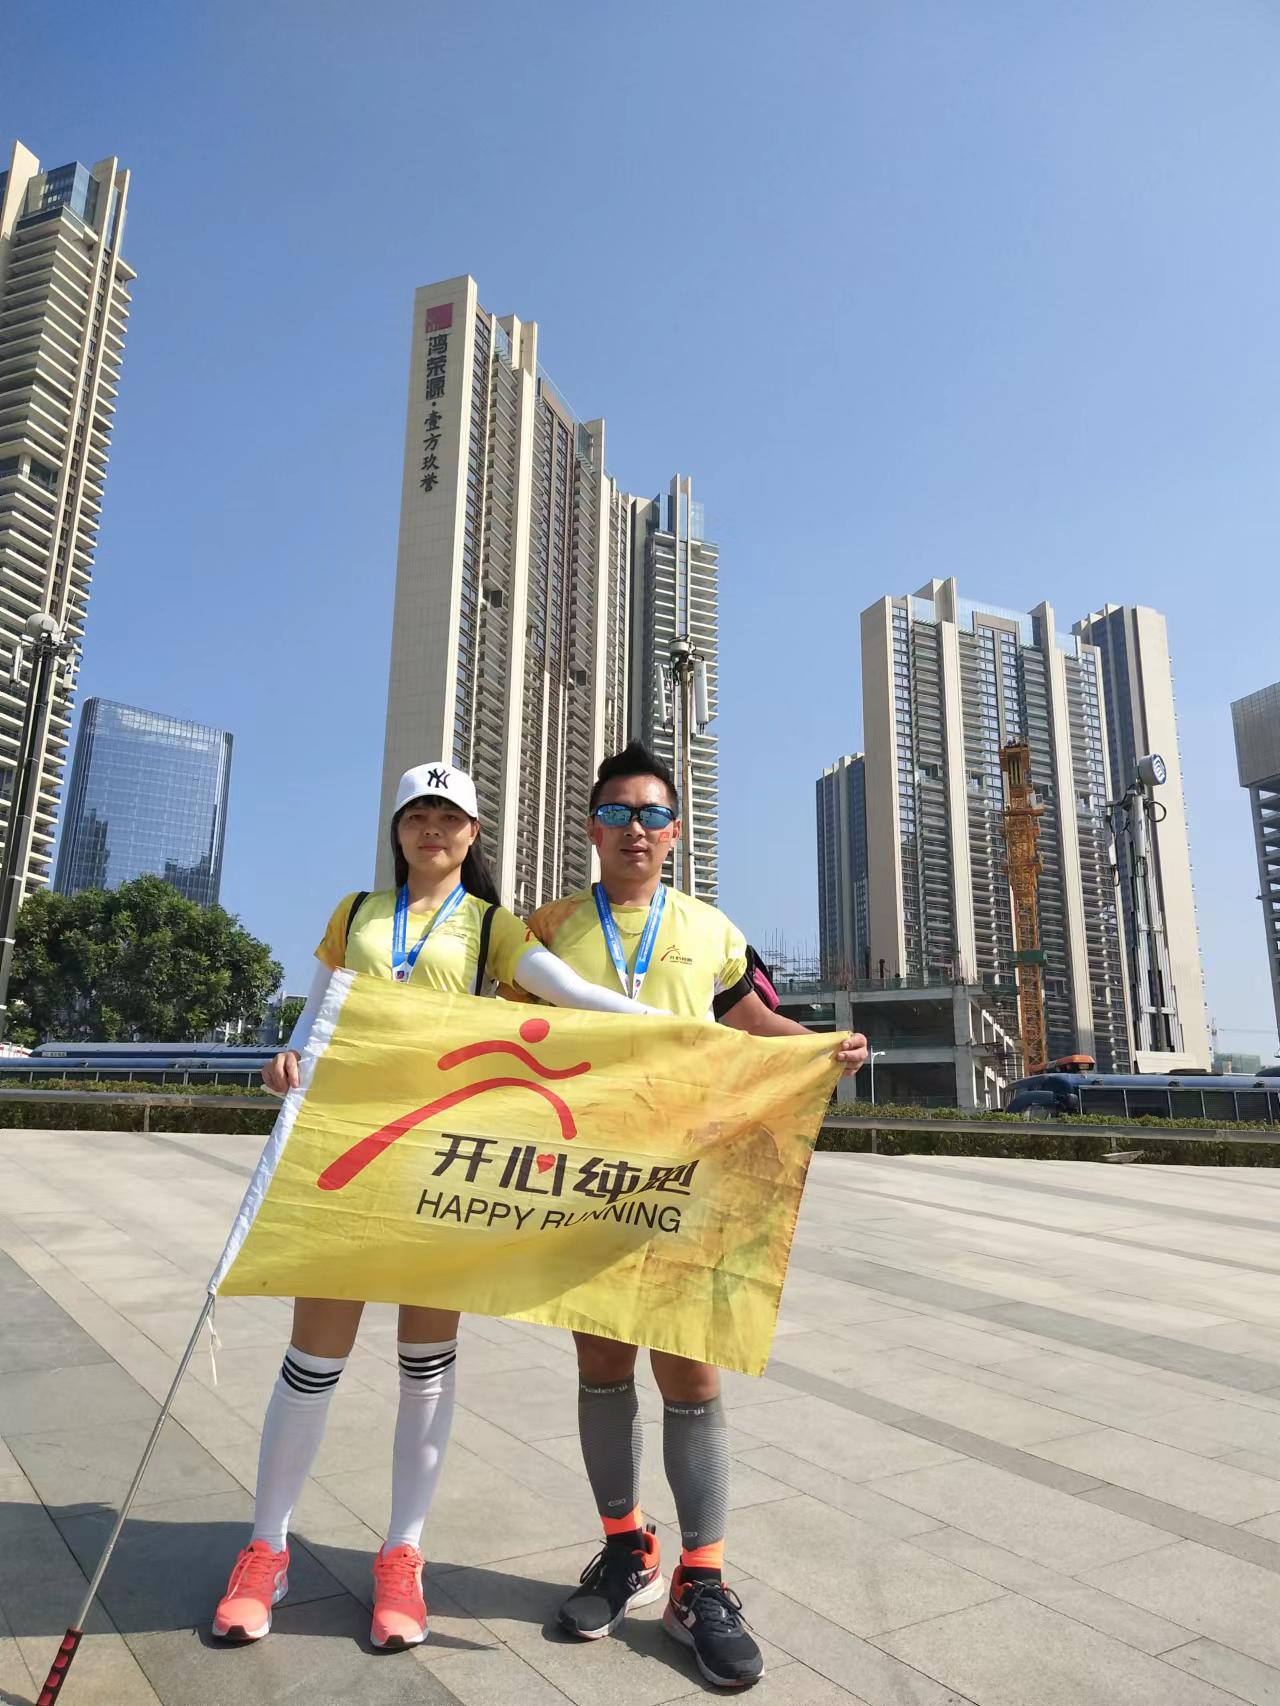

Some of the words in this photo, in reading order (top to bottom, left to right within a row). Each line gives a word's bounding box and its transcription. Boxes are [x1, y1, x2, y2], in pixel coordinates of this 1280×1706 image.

[65, 663, 72, 674] 2
[427, 768, 450, 789] NY
[416, 1189, 535, 1230] HAPPY
[540, 1202, 681, 1233] RUNNING
